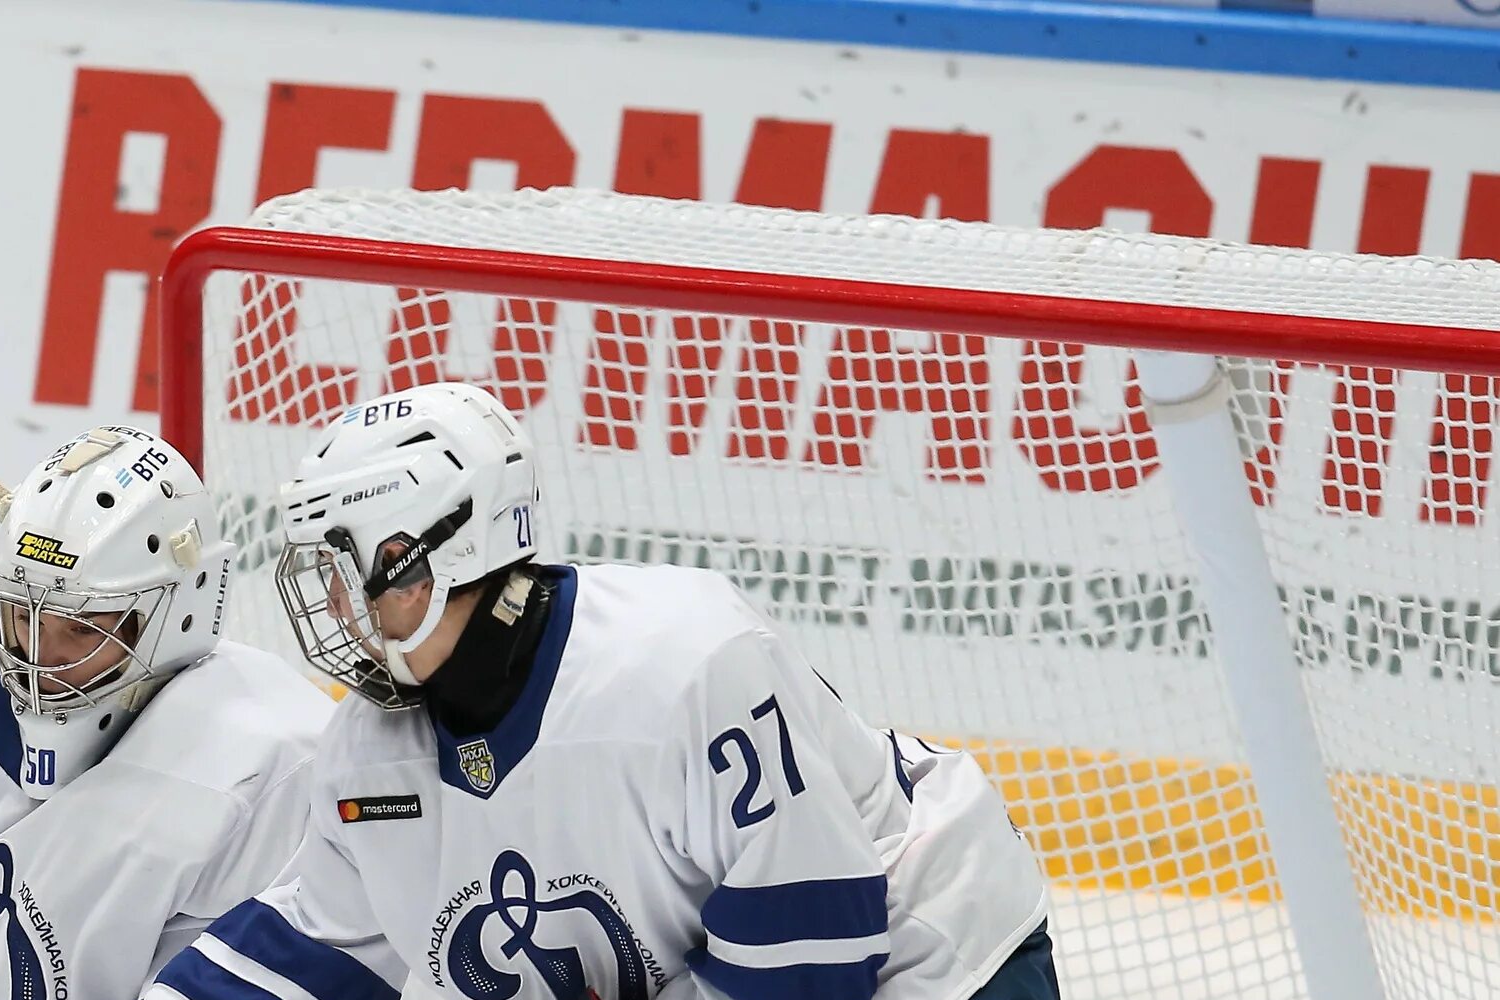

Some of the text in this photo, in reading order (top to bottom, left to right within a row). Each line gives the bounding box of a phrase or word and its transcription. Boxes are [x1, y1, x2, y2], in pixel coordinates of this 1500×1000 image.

[363, 398, 413, 427] ВТБ
[130, 446, 170, 483] ВТБ
[23, 534, 60, 551] PARI
[513, 504, 533, 549] 27
[28, 546, 76, 569] MATCH
[26, 743, 56, 786] 50
[707, 693, 807, 830] 27
[362, 801, 418, 814] mastercard
[428, 879, 483, 988] МОЛОДЕЖНАЯ
